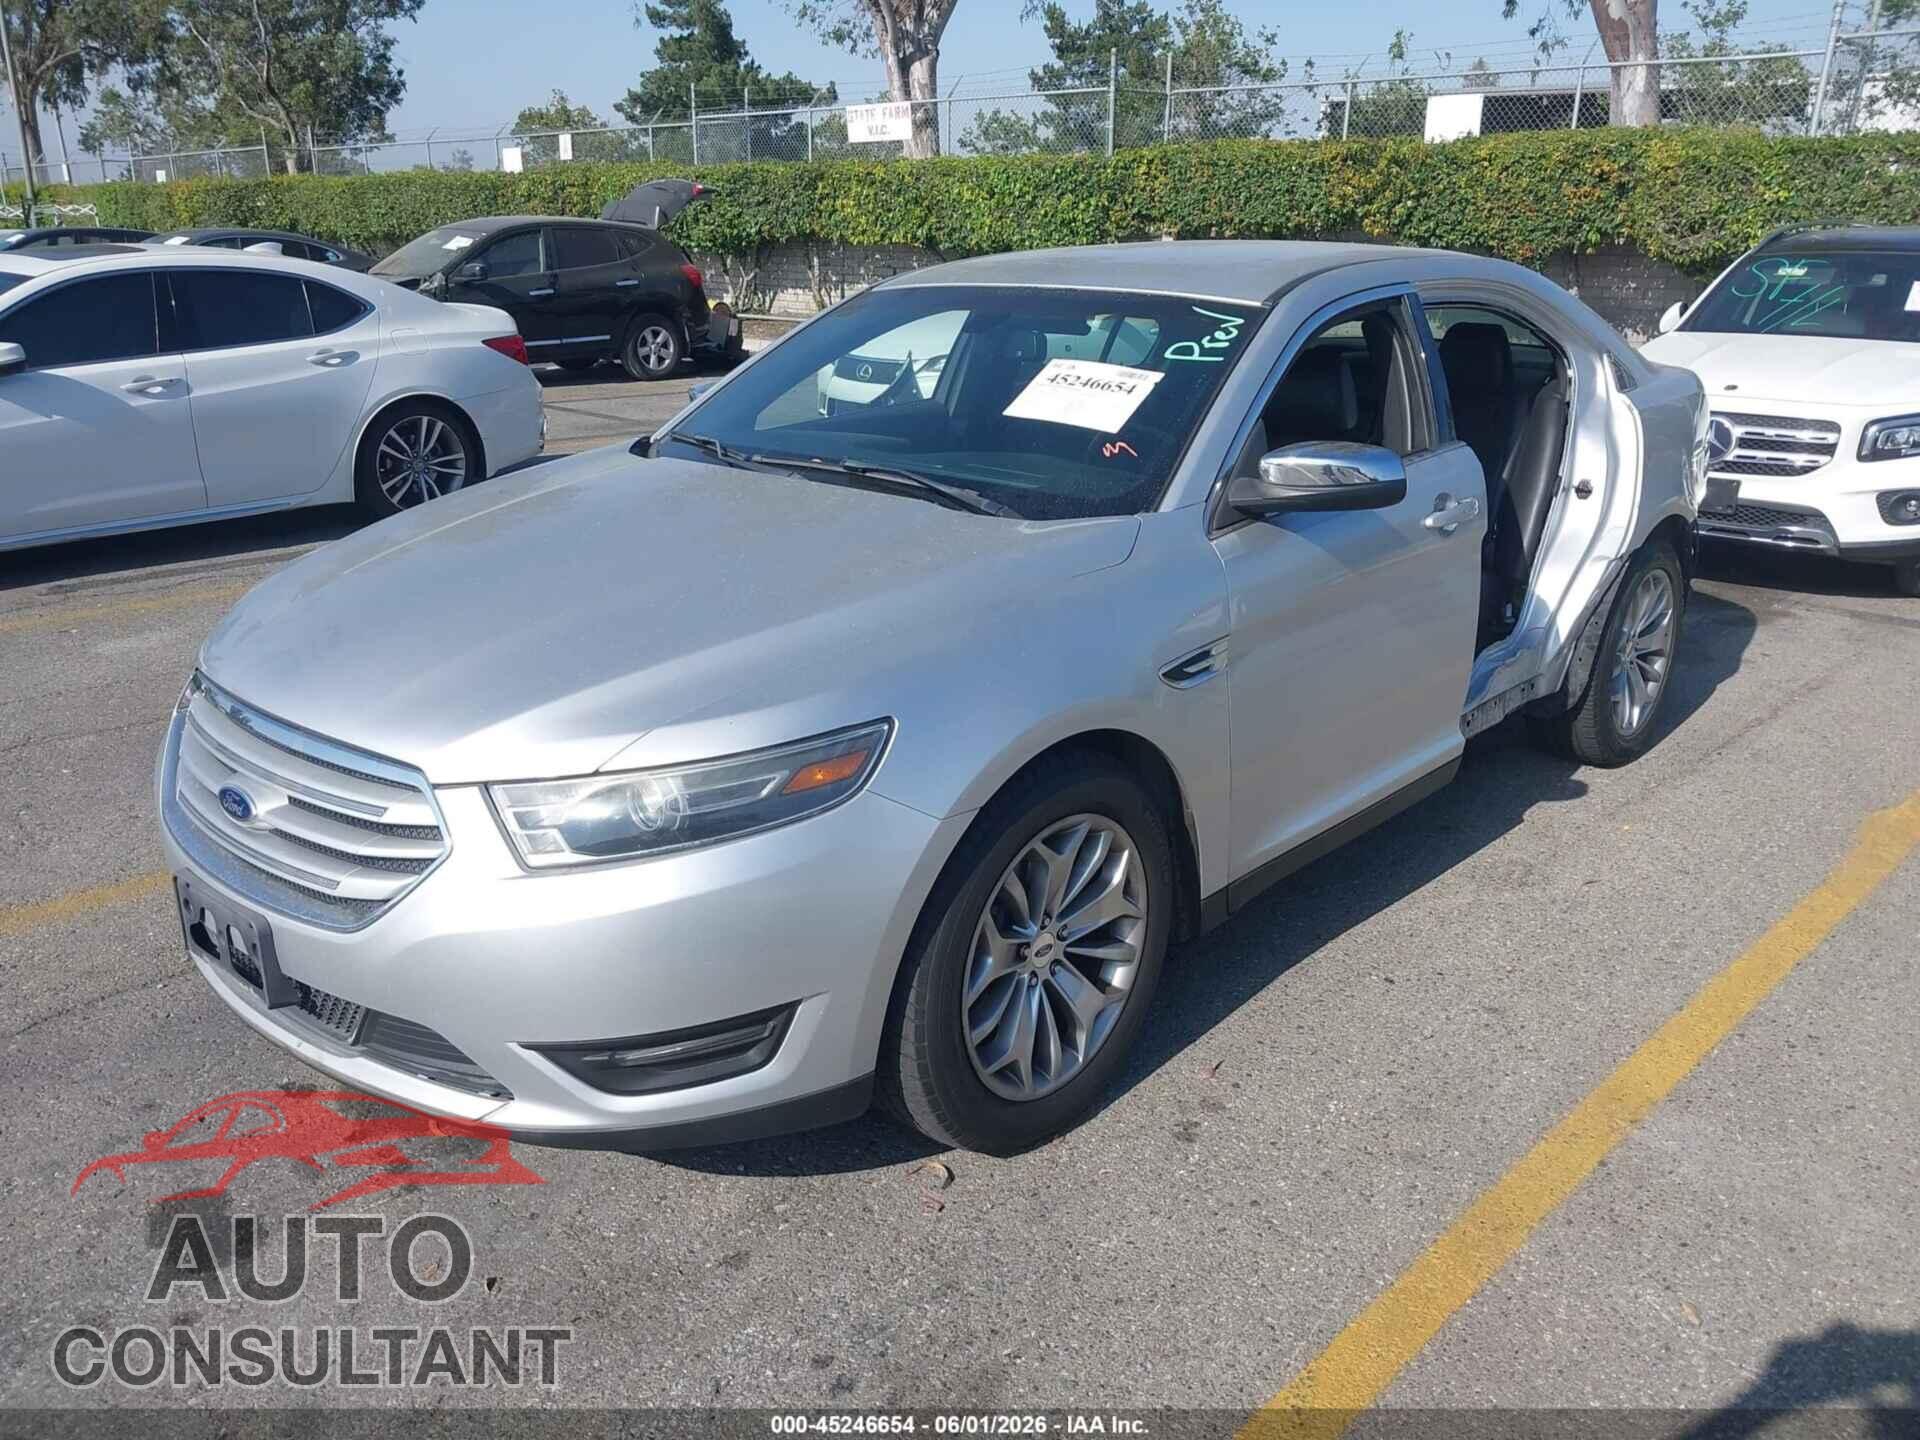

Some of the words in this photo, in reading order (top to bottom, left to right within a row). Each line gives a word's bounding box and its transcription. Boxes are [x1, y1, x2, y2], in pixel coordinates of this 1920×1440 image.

[881, 105, 910, 121] FARM
[1046, 371, 1138, 396] 45246654
[222, 790, 249, 818] Ford
